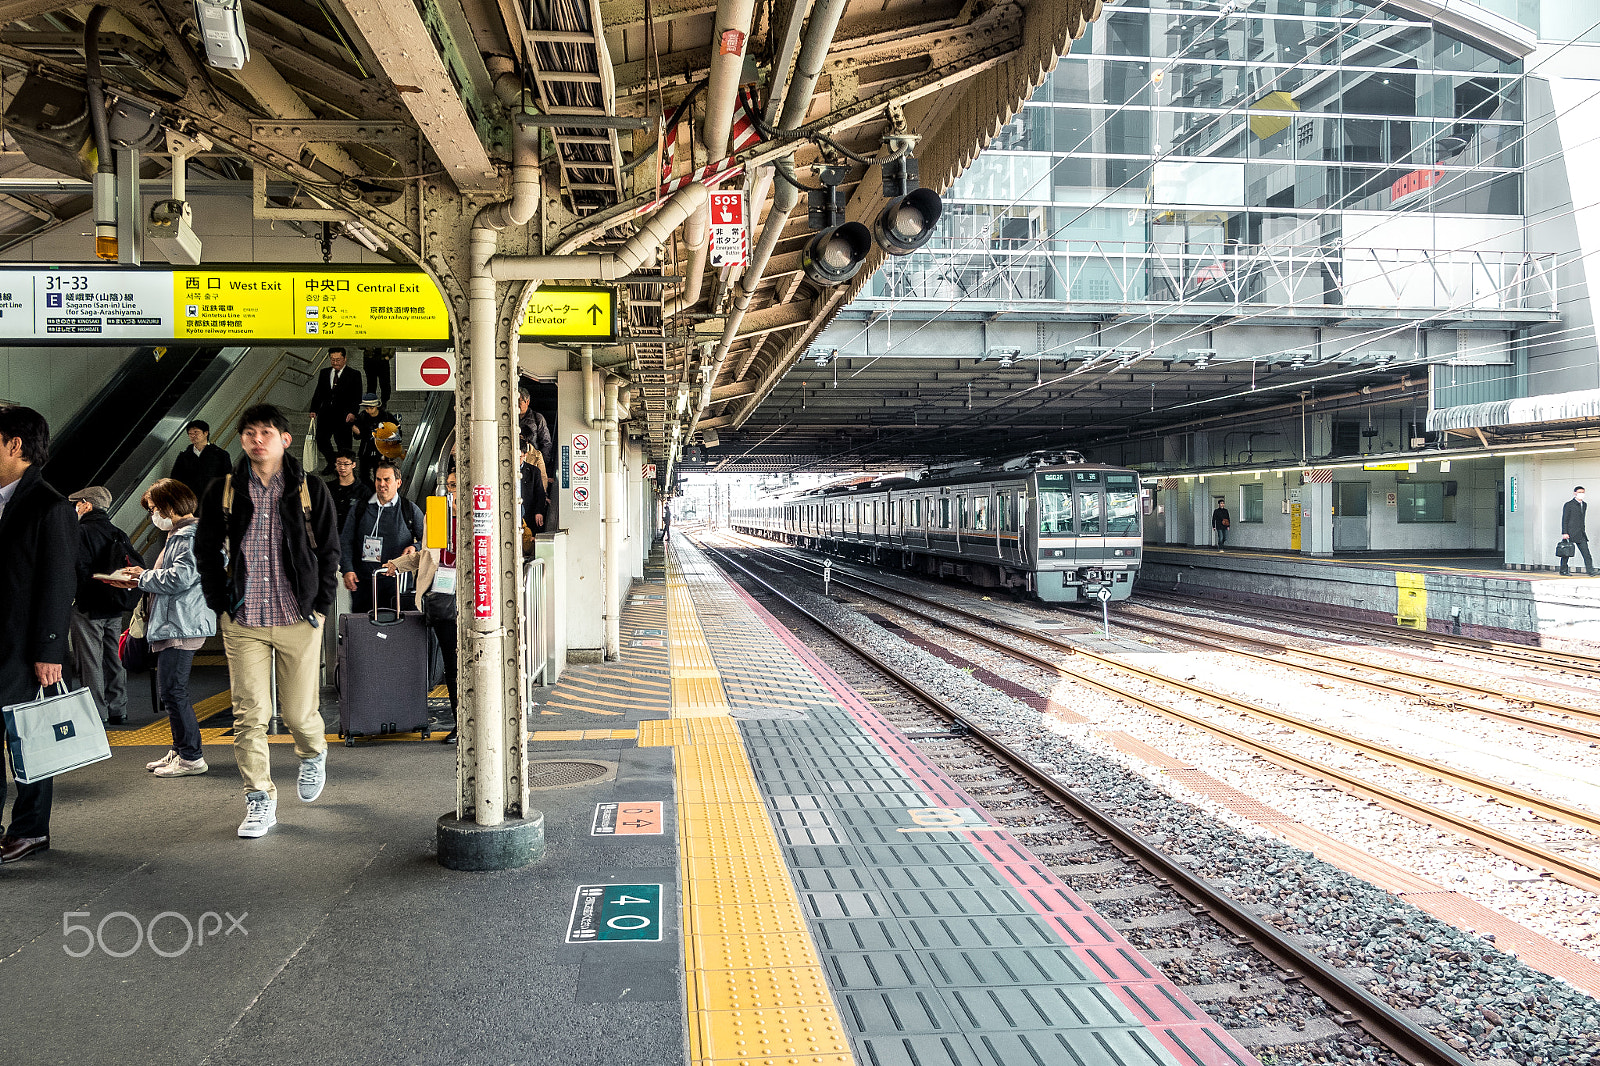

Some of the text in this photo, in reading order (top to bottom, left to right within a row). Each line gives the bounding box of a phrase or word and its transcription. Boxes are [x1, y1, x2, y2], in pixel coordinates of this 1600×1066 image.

[714, 196, 738, 205] SOS
[46, 276, 88, 290] 31-33
[185, 277, 282, 290] 西口 West Exit
[305, 279, 420, 293] 中央口 Central Exit
[65, 302, 91, 310] Sagano
[369, 306, 426, 314] 京都鉄道博物館
[528, 304, 580, 315] エレベーター
[186, 320, 243, 328] 京都鉄道博物館
[528, 316, 568, 324] Elevator
[478, 538, 488, 602] 左側にあります
[1101, 590, 1107, 599] 7
